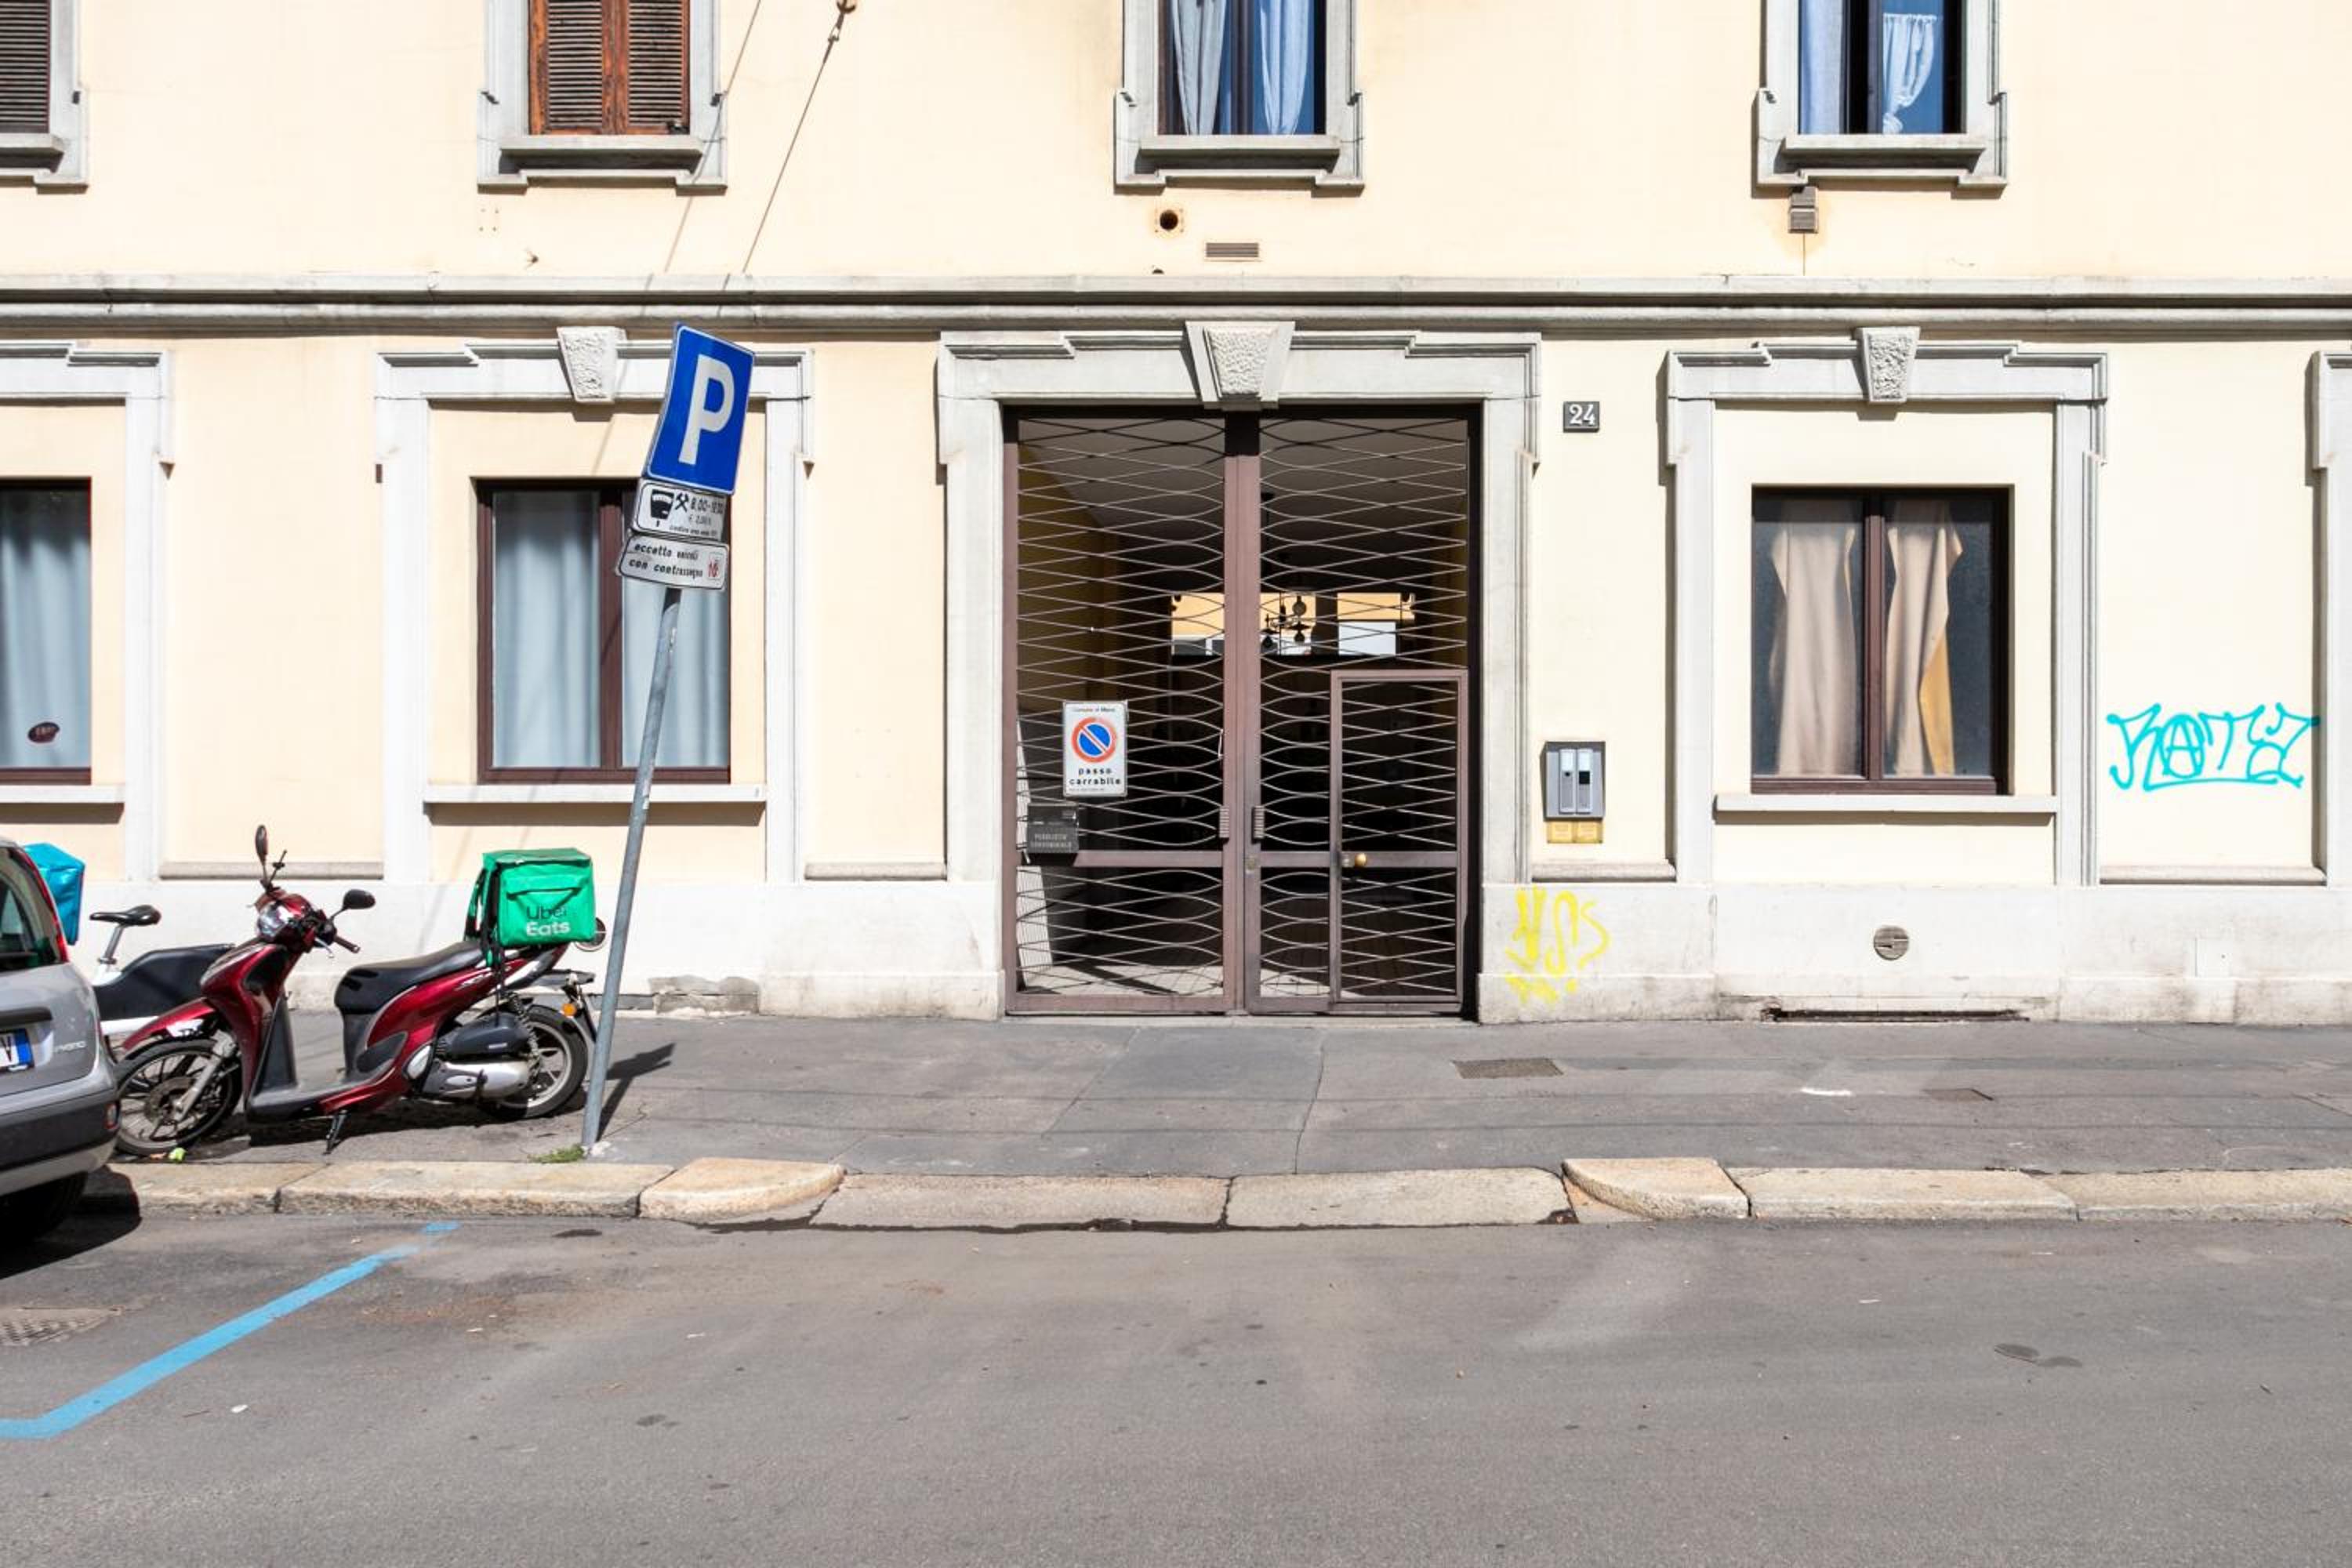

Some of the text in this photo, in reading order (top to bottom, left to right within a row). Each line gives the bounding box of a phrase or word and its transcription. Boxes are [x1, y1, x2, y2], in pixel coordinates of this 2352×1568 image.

[677, 354, 735, 465] P
[1569, 404, 1595, 425] 24
[634, 543, 672, 557] eccetto
[629, 559, 648, 569] con
[1078, 768, 1112, 777] passo
[1069, 777, 1121, 786] carrabile
[526, 921, 571, 937] Eats
